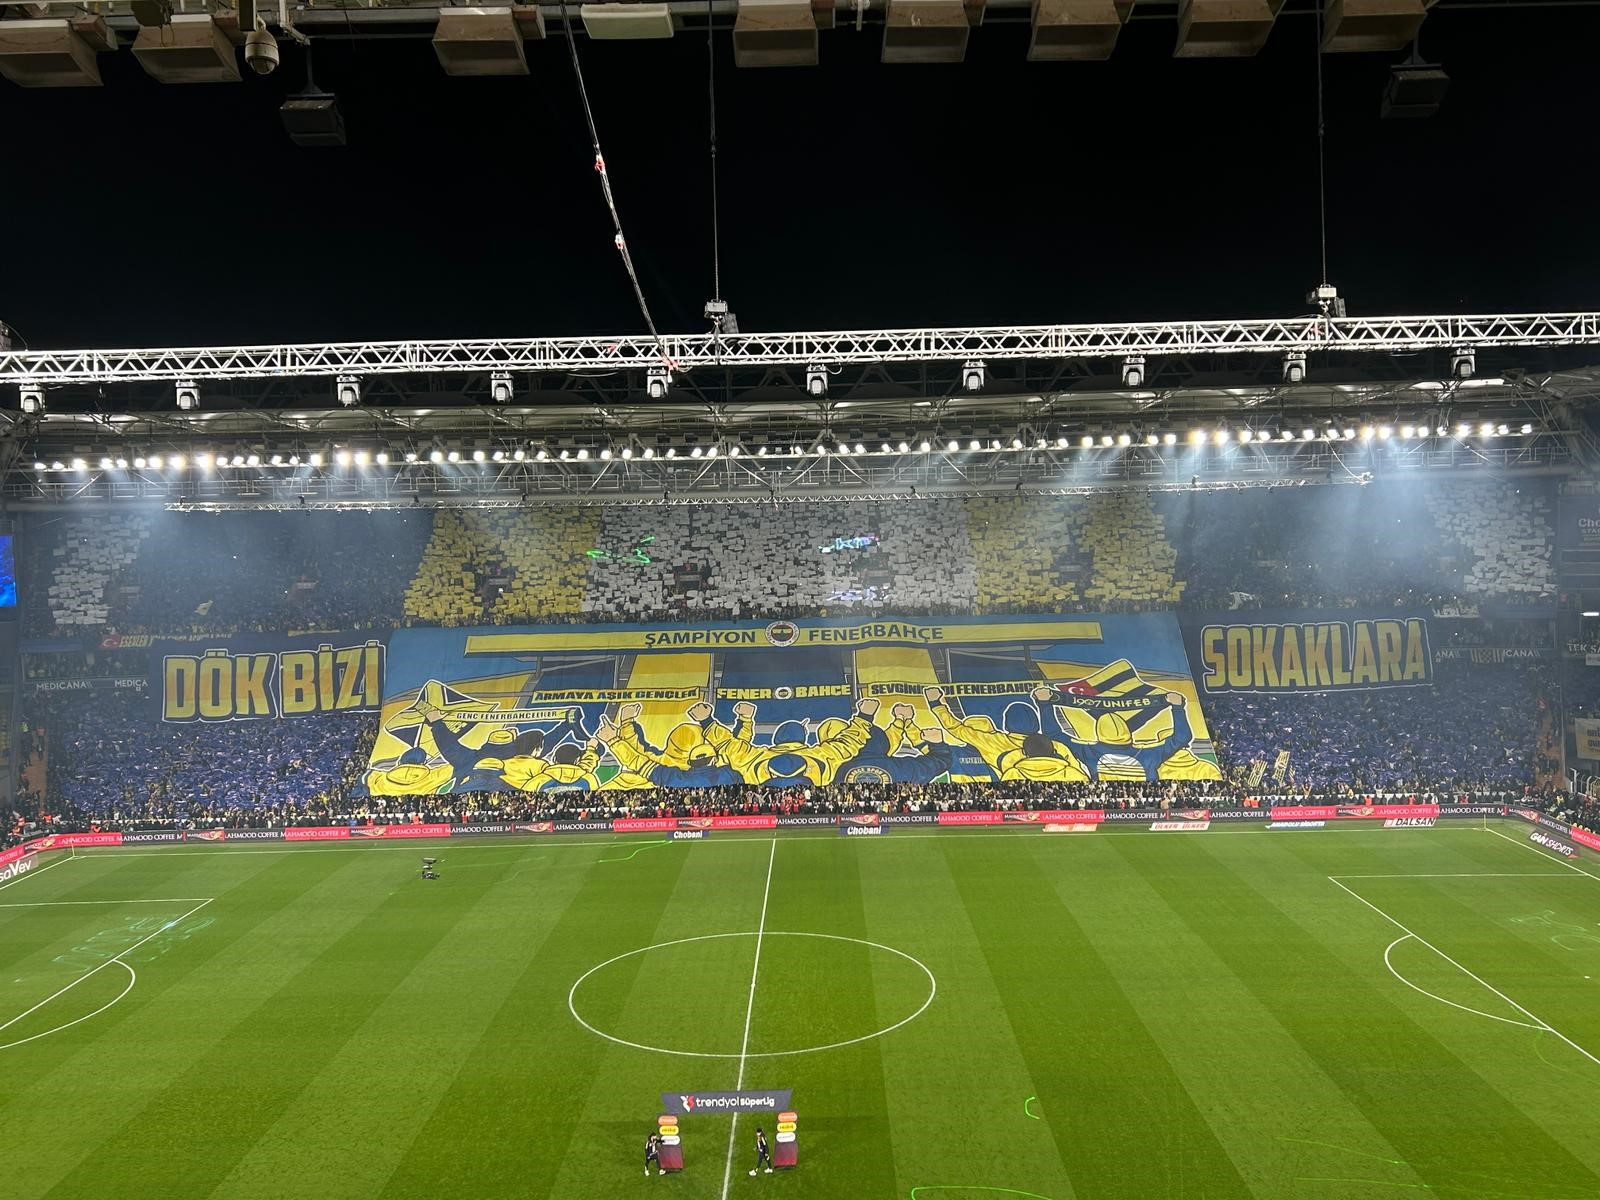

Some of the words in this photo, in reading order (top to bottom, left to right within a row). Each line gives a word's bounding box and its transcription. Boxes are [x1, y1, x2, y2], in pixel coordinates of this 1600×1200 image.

[645, 630, 756, 648] ŞAMPİYON
[809, 624, 944, 643] FENERBAHÇE
[1202, 617, 1432, 693] SOKAKLARA
[36, 679, 87, 691] MEDICANA
[163, 649, 278, 723] DÖK
[279, 640, 385, 719] BİZİ
[535, 691, 593, 700] ARMAYA
[716, 688, 772, 699] FENER
[1136, 811, 1158, 819] COFFEE
[1395, 817, 1435, 826] DALSAN
[673, 830, 703, 839] Chobani
[847, 825, 882, 835] Chobani
[695, 1096, 740, 1109] trendyol
